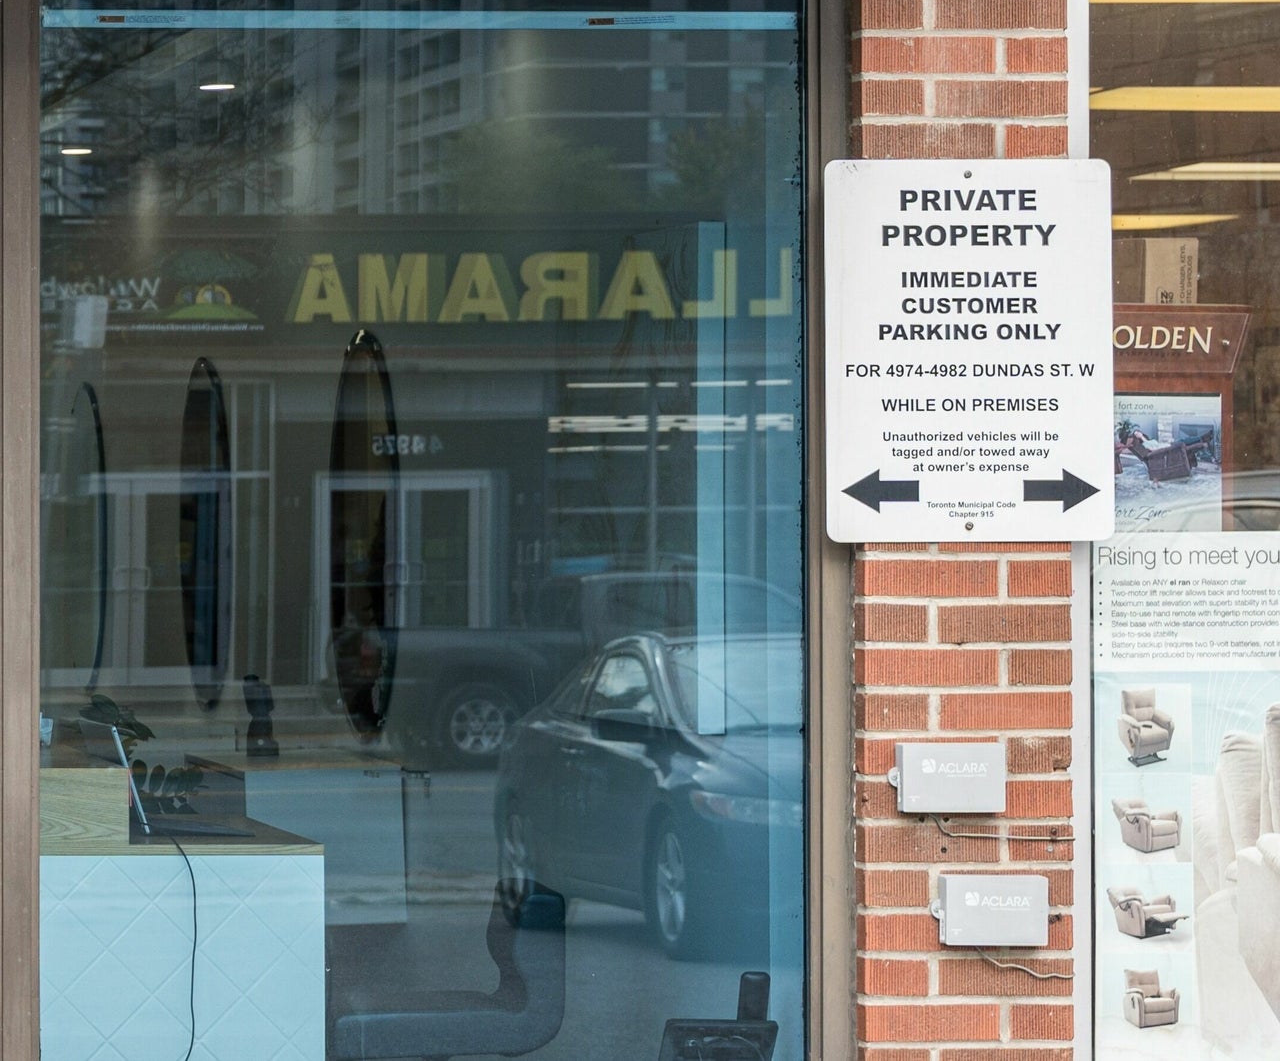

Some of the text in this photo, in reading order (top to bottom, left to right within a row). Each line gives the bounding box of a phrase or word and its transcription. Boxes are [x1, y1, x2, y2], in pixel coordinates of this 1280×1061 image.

[899, 189, 1038, 211] PRIVATE
[881, 224, 1056, 247] PROPERTY
[901, 271, 1038, 288] IMMEDIATE
[901, 297, 1038, 314] CUSTOMER
[878, 323, 1062, 341] PARKING ONLY
[845, 363, 1095, 378] FOR 4974-4982 DUNDAS ST. W
[881, 398, 1059, 412] WHILE ON PREMISES
[882, 431, 1059, 442] Unauthorized vehicles will be
[891, 446, 1050, 459] tagged and/or towed away
[913, 462, 1030, 474] at owner's expense
[958, 501, 994, 509] Municipal
[948, 510, 978, 518] Chapter
[1098, 546, 1157, 570] Rising
[1163, 547, 1183, 565] to
[1189, 547, 1239, 565] meet
[1111, 589, 1148, 597] Two-motor
[1161, 599, 1191, 607] elevation
[1209, 599, 1233, 608] superb
[1234, 599, 1259, 607] stability
[1111, 610, 1151, 618] Easy-to-use
[1213, 609, 1240, 618] fingertip
[1111, 620, 1128, 628] Steel
[1130, 620, 1146, 628] base
[1250, 620, 1279, 628] provides
[1111, 630, 1178, 639] side-to-side stability
[1111, 641, 1135, 649] Battery
[1137, 641, 1162, 649] backup
[1209, 640, 1229, 648] 9-volt
[1111, 651, 1150, 659] Mechanism
[1152, 651, 1184, 659] produced
[1186, 651, 1195, 659] by
[1232, 650, 1277, 658] manufacturer
[938, 762, 988, 774] ACLARA
[981, 895, 1030, 907] ACLARA
